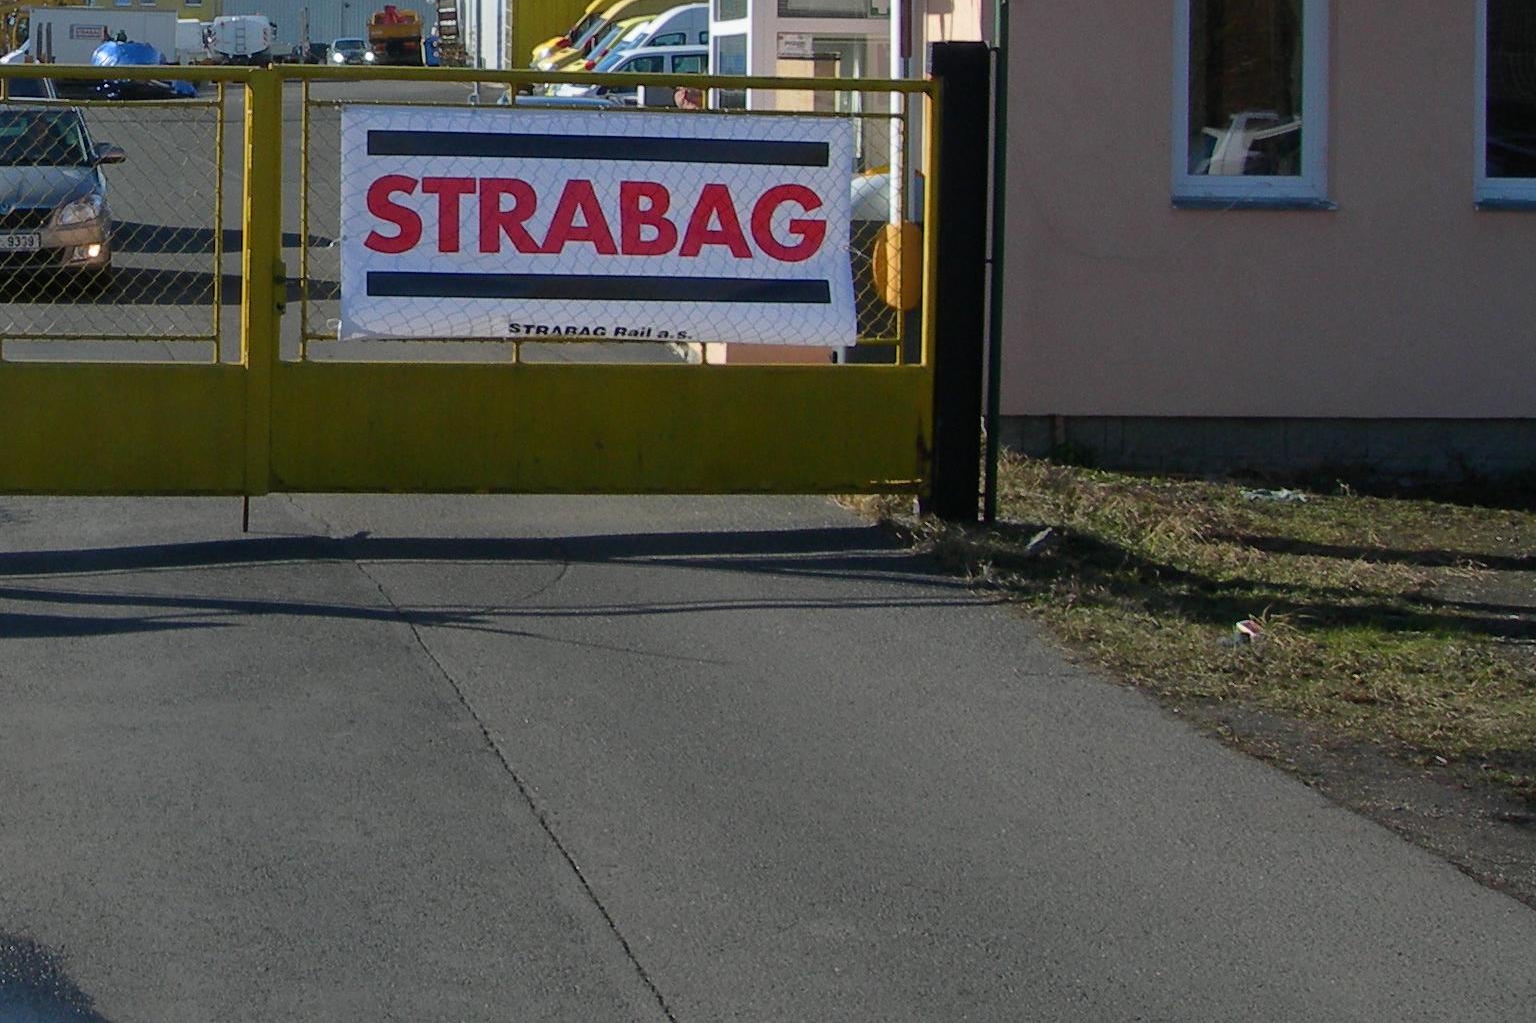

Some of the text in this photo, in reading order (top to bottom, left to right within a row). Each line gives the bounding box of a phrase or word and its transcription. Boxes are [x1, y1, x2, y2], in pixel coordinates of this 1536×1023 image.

[364, 174, 827, 262] STRABAG
[508, 322, 693, 340] STRABAG Rail a.s.
